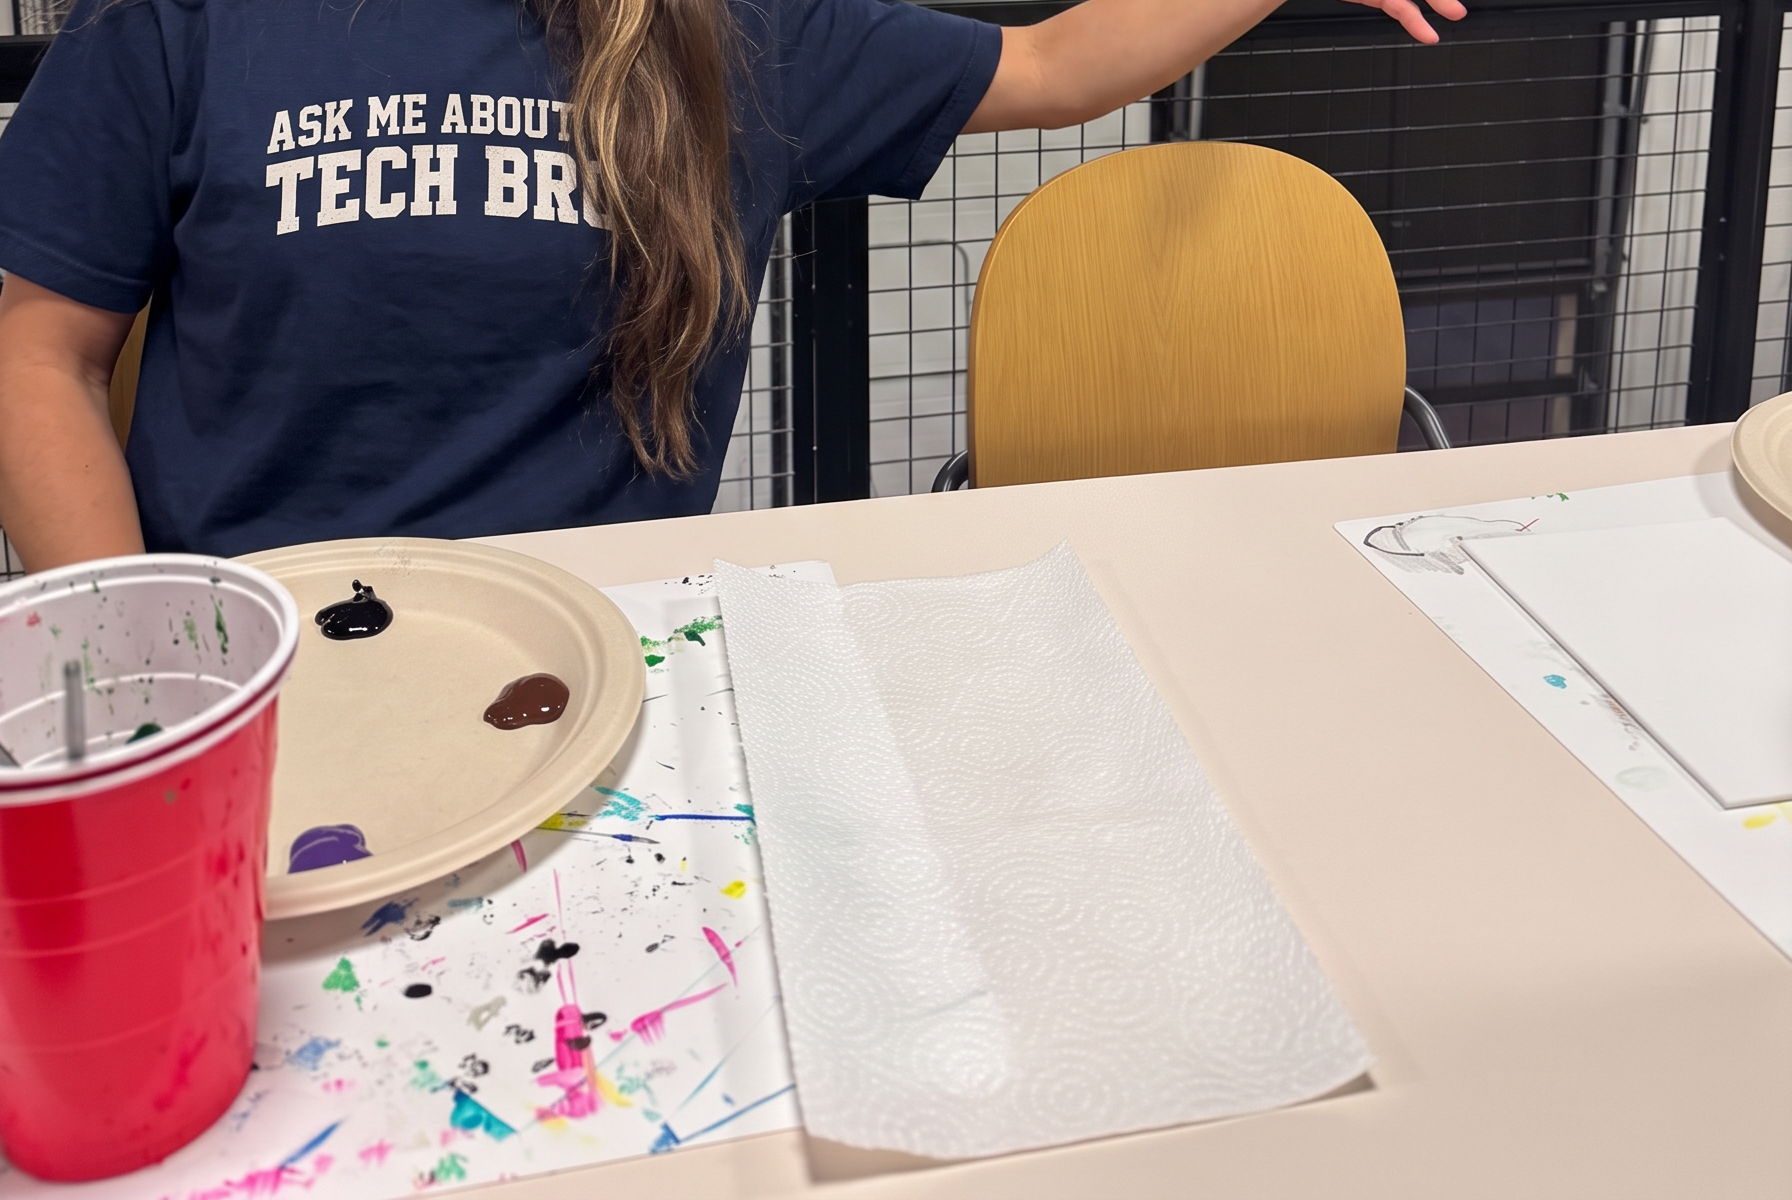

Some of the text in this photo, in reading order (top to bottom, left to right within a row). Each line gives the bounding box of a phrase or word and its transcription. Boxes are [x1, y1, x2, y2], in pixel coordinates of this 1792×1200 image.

[266, 93, 575, 154] ASK ME ABOUT
[265, 144, 458, 236] TECH
